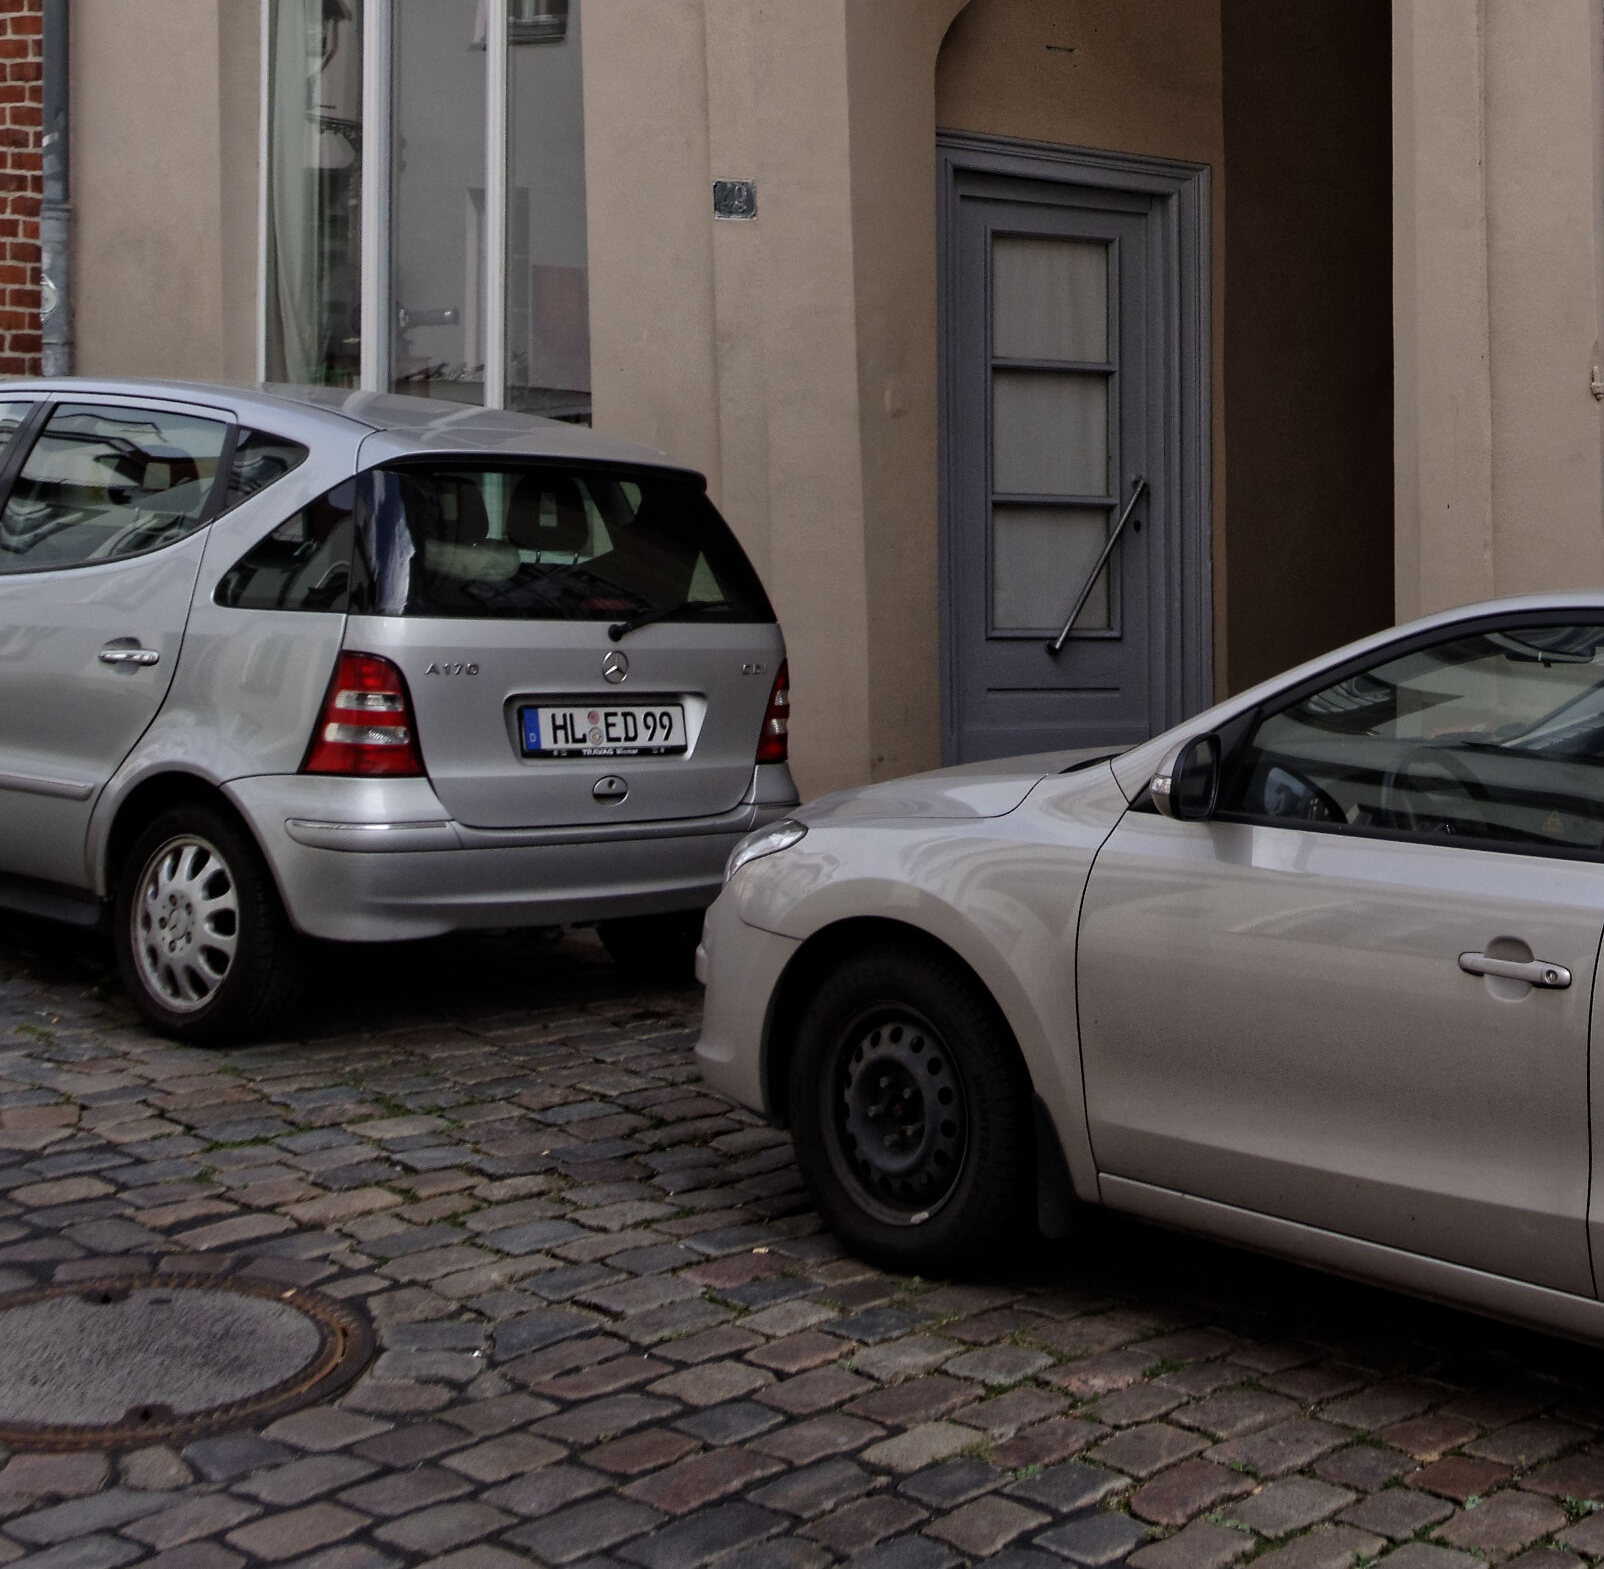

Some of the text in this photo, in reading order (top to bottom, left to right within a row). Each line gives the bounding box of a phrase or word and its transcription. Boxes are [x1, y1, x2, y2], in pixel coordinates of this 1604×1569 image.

[551, 711, 673, 744] HL ED 99
